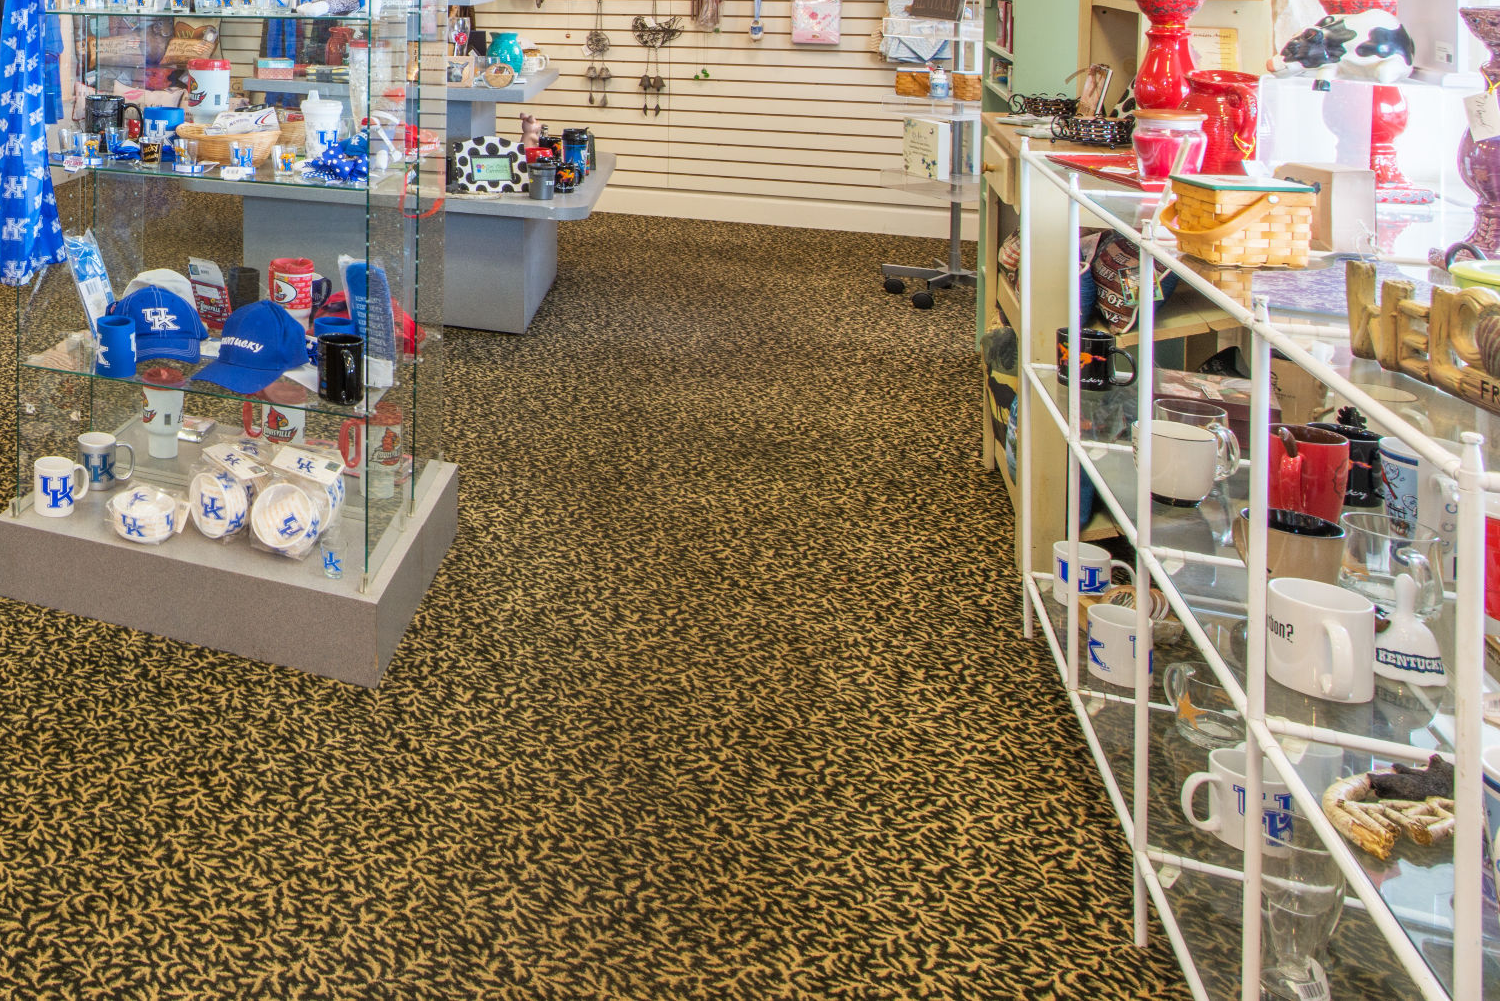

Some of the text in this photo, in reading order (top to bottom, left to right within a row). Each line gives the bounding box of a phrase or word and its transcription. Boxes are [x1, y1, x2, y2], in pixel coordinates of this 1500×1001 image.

[1107, 294, 1126, 309] OF
[141, 307, 181, 331] UK
[82, 452, 117, 484] UK
[295, 456, 316, 474] UK
[39, 474, 75, 509] UK
[200, 492, 225, 520] UK
[121, 513, 146, 538] UK
